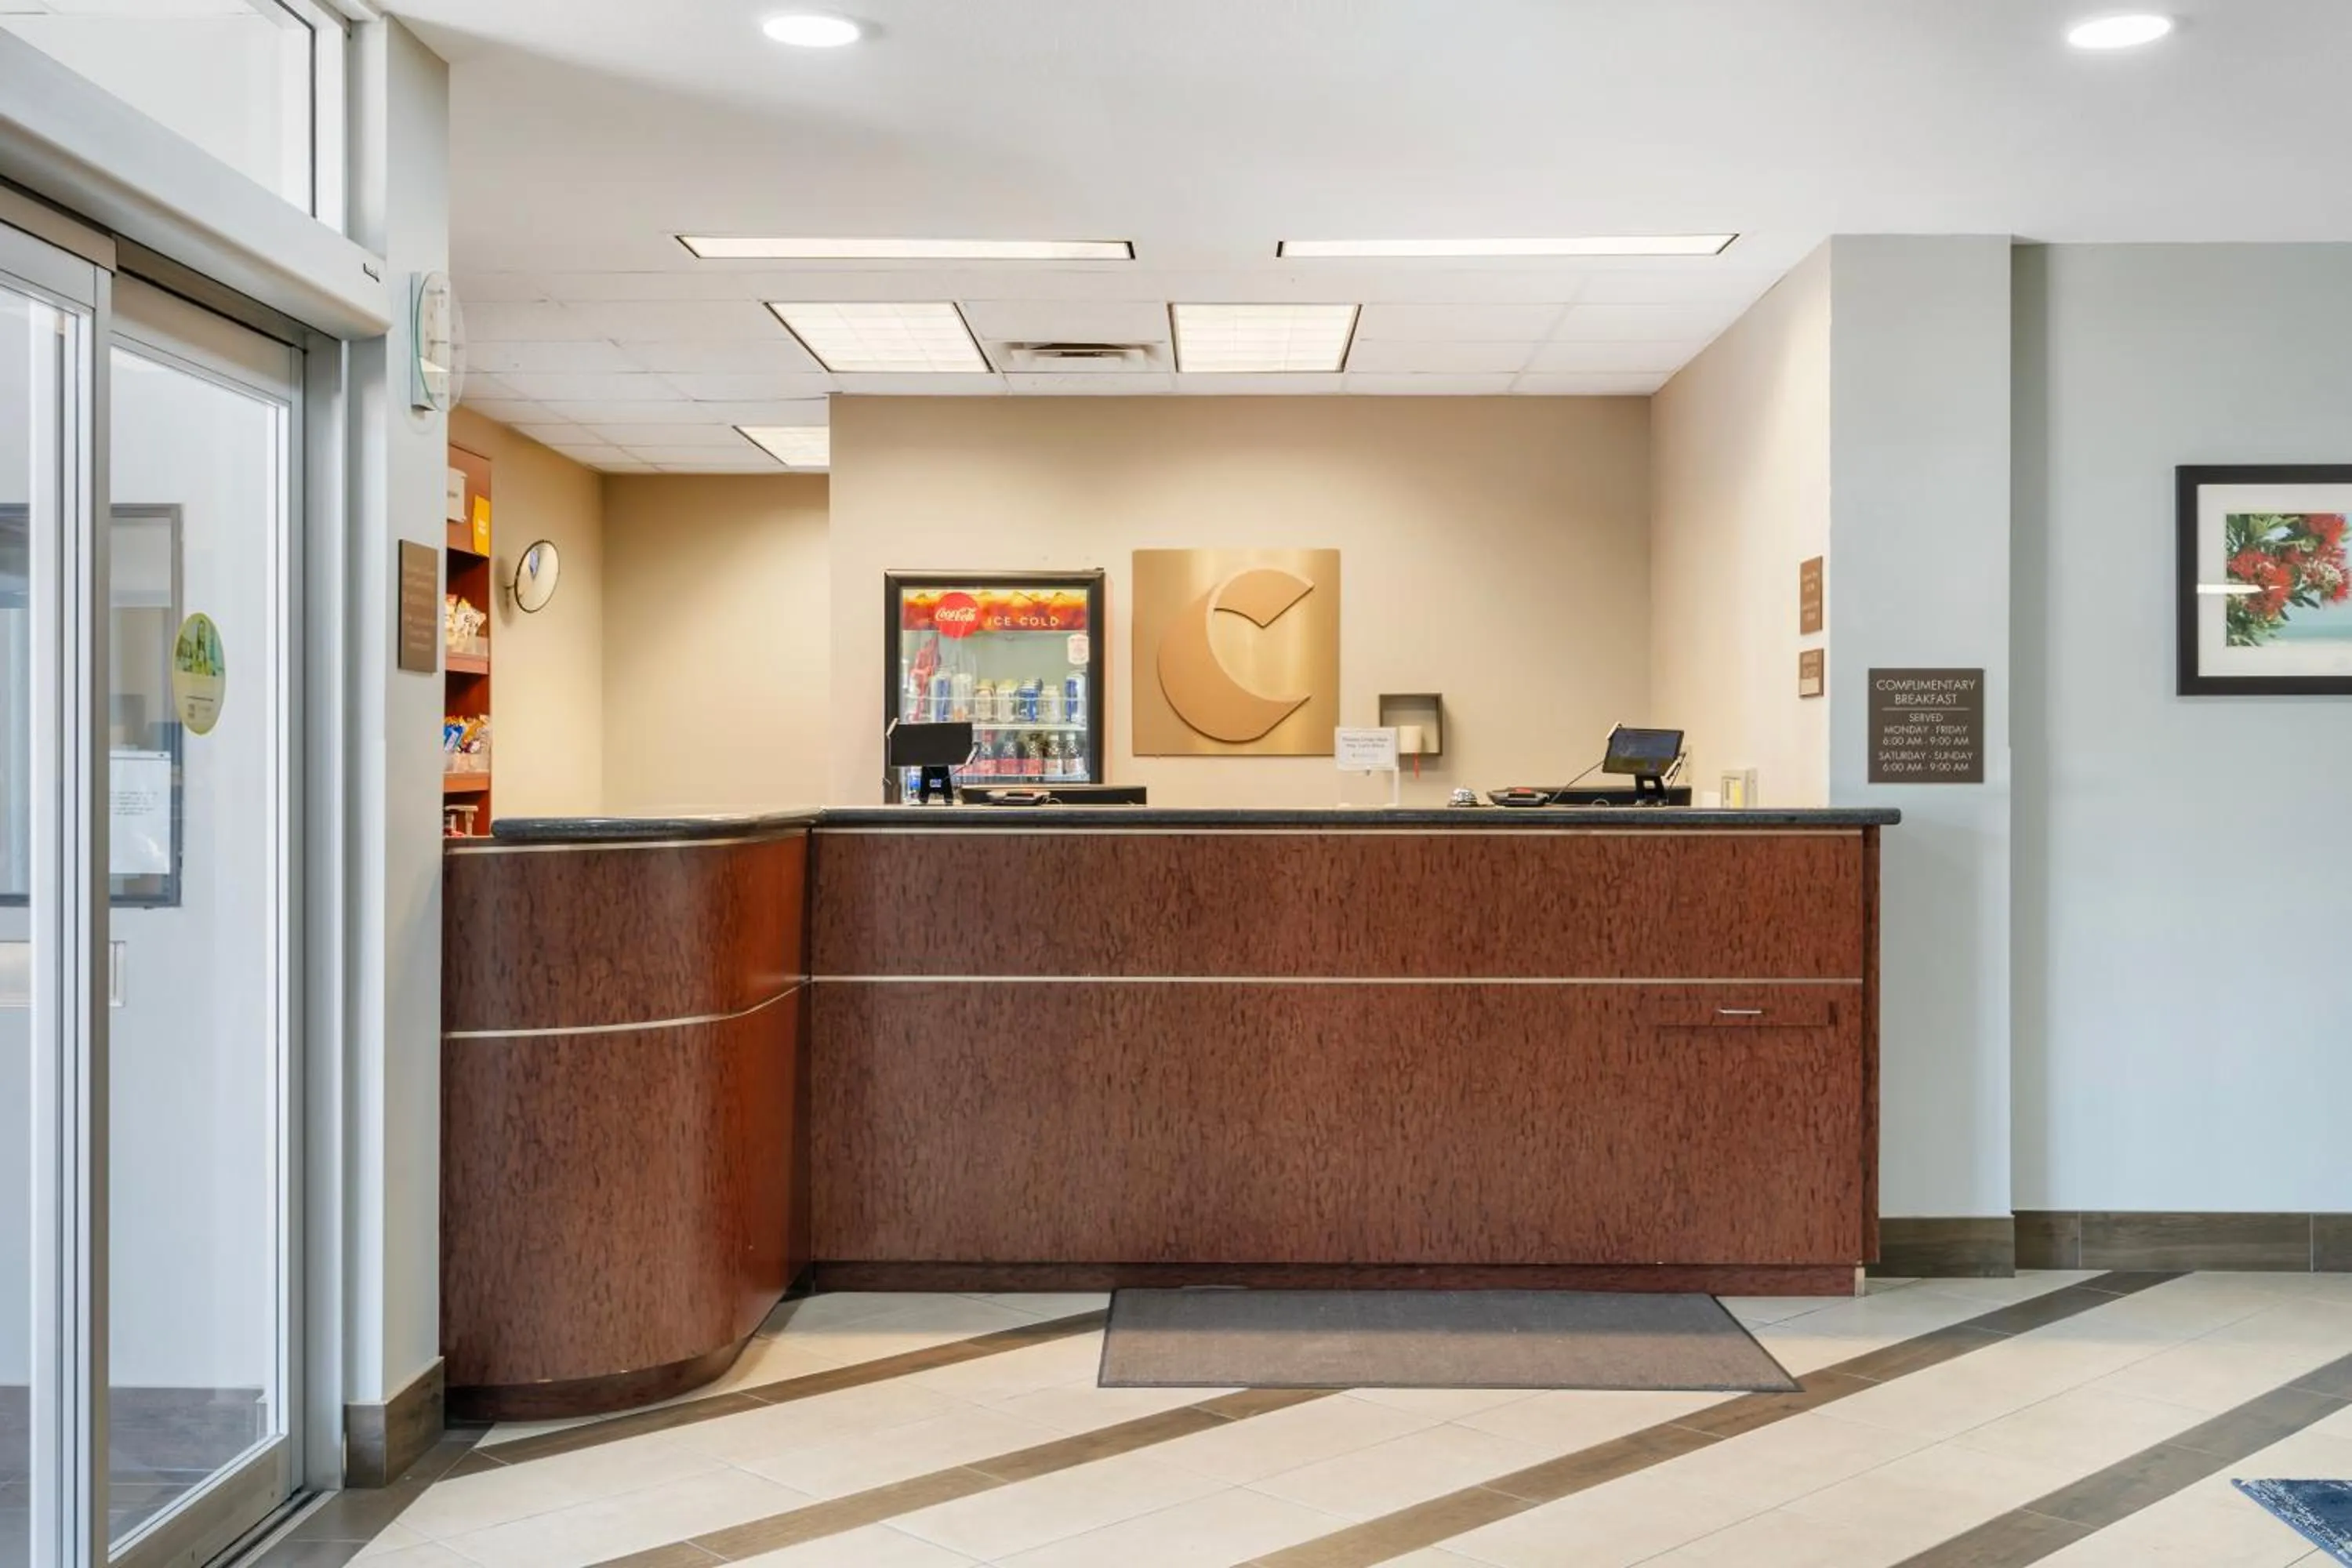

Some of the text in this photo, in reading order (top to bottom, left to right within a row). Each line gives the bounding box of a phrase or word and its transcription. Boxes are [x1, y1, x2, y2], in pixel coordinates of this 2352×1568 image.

[987, 615, 1060, 626] ICE COLD
[1876, 680, 1975, 691] COMPLIMENTARY
[1895, 693, 1958, 705] BREAKFAST
[1909, 713, 1944, 722] SERVED
[1884, 725, 1928, 735] MONDAY
[1936, 725, 1968, 735] FRIDAY
[1882, 737, 1904, 746] 6:00
[1906, 737, 1922, 746] AM
[1929, 737, 1951, 746] 9:00
[1953, 737, 1969, 746] AM
[1878, 751, 1926, 760] SATURDAY
[1935, 751, 1973, 760] SUNDAY
[1882, 763, 1904, 772] 6:00
[1906, 763, 1922, 771] AM
[1929, 763, 1951, 772] 9:00
[1953, 763, 1969, 771] AM
